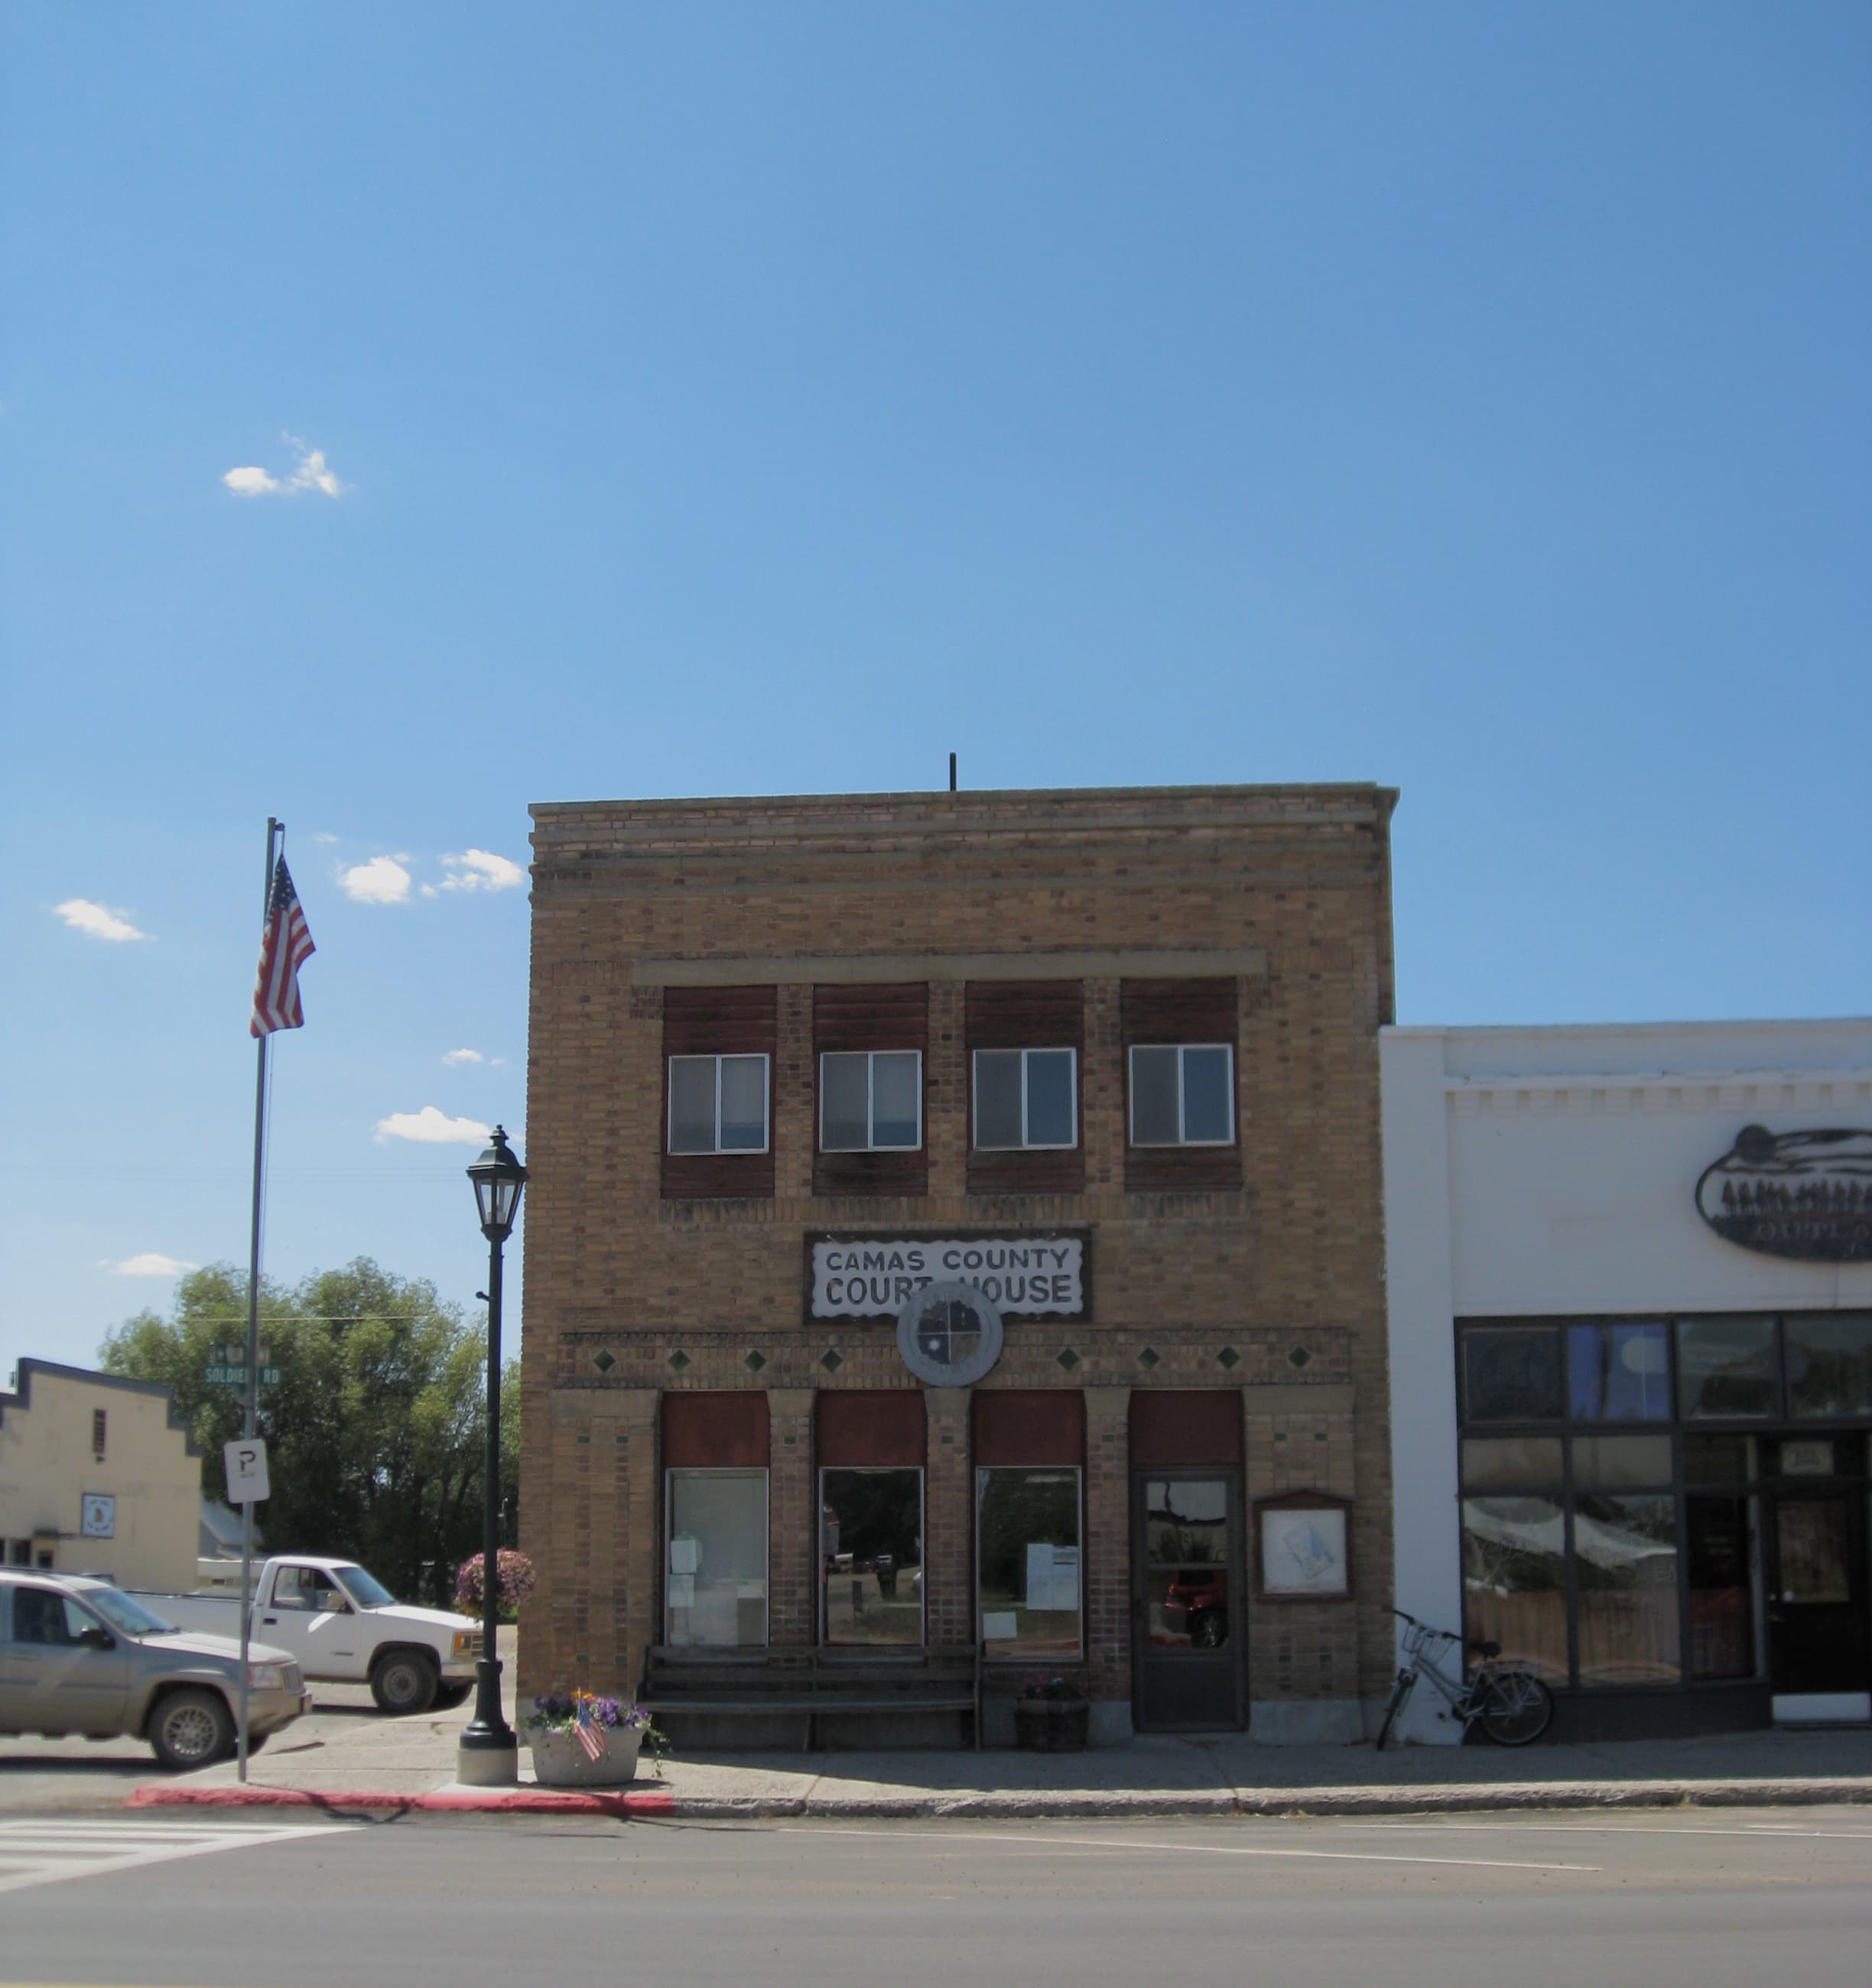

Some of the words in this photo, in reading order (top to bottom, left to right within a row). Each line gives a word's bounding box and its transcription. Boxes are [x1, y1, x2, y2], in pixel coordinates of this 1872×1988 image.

[826, 1251, 925, 1271] CAMAS
[942, 1248, 1069, 1270] COUNTY
[826, 1276, 933, 1305] COURT
[263, 1369, 280, 1383] RD
